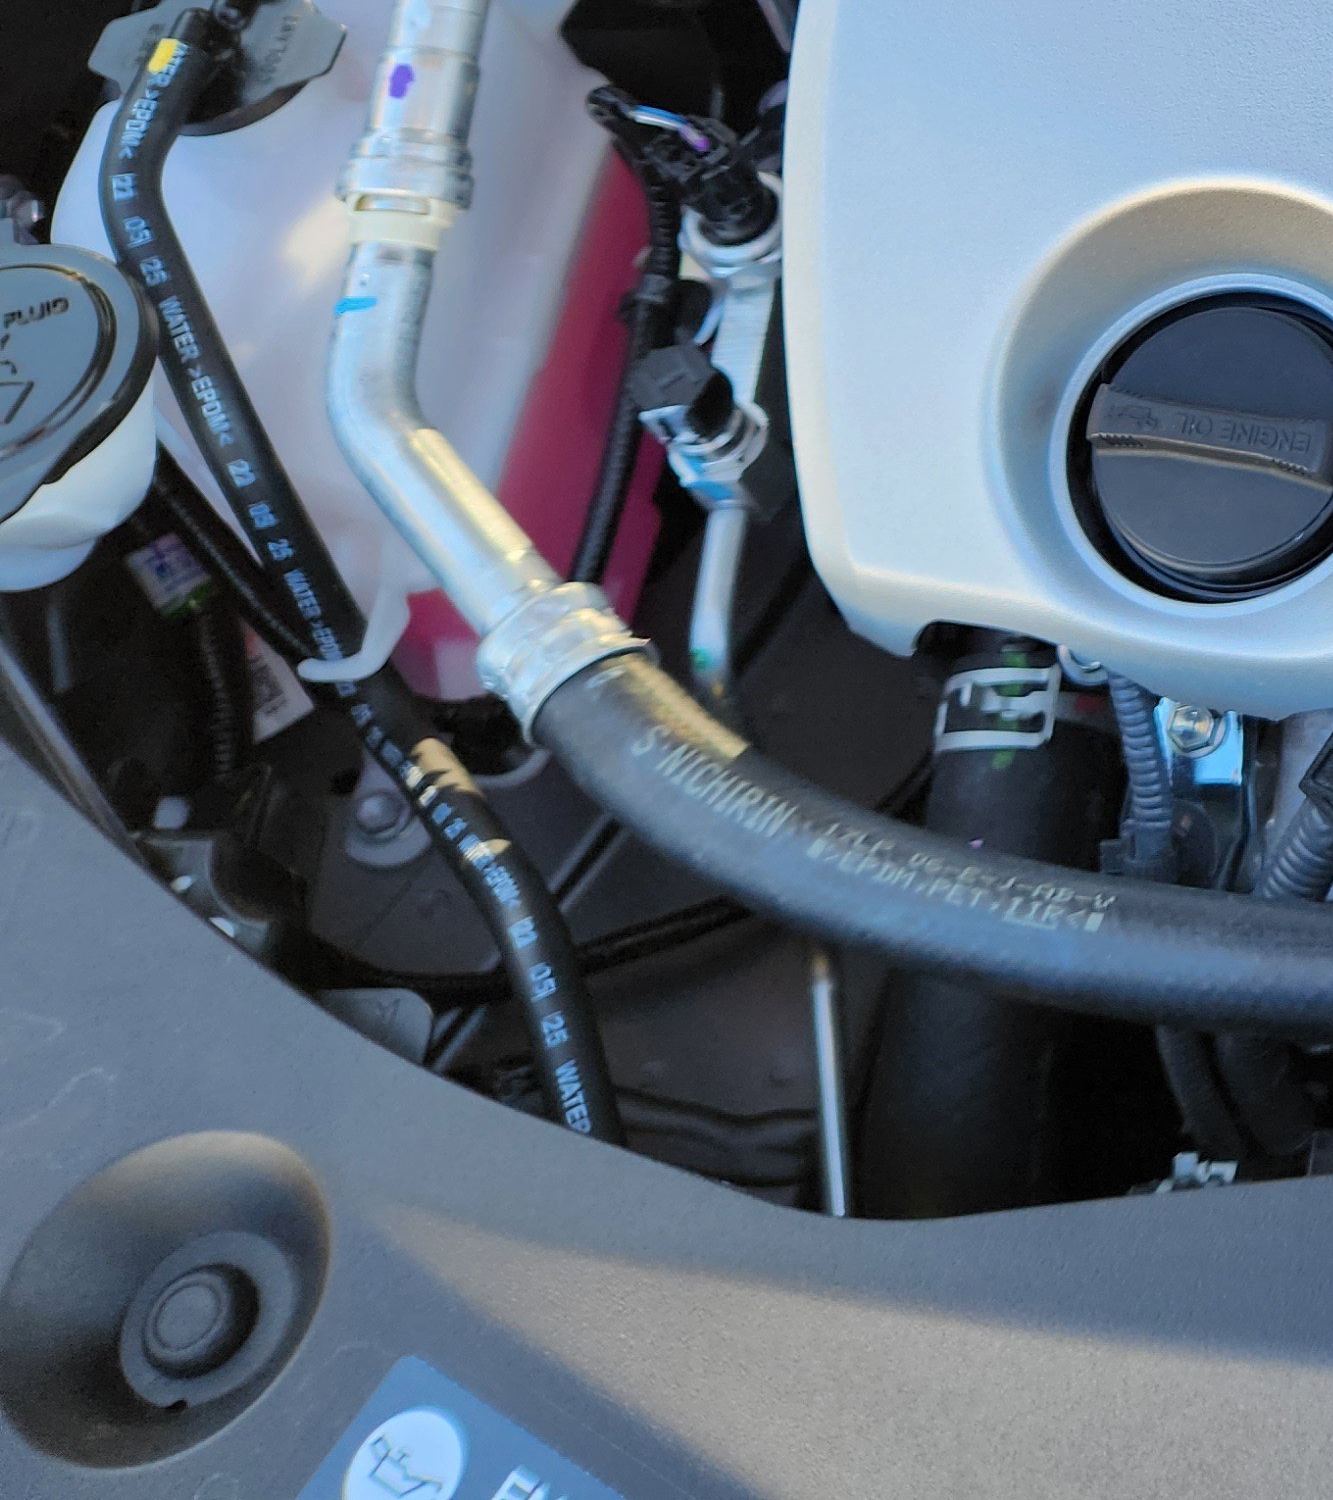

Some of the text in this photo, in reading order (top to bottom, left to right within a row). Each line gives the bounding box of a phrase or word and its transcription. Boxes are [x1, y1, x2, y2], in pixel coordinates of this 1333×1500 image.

[159, 295, 201, 364] WATER
[1176, 412, 1312, 454] ENGINE OIL
[541, 1010, 570, 1048] 25
